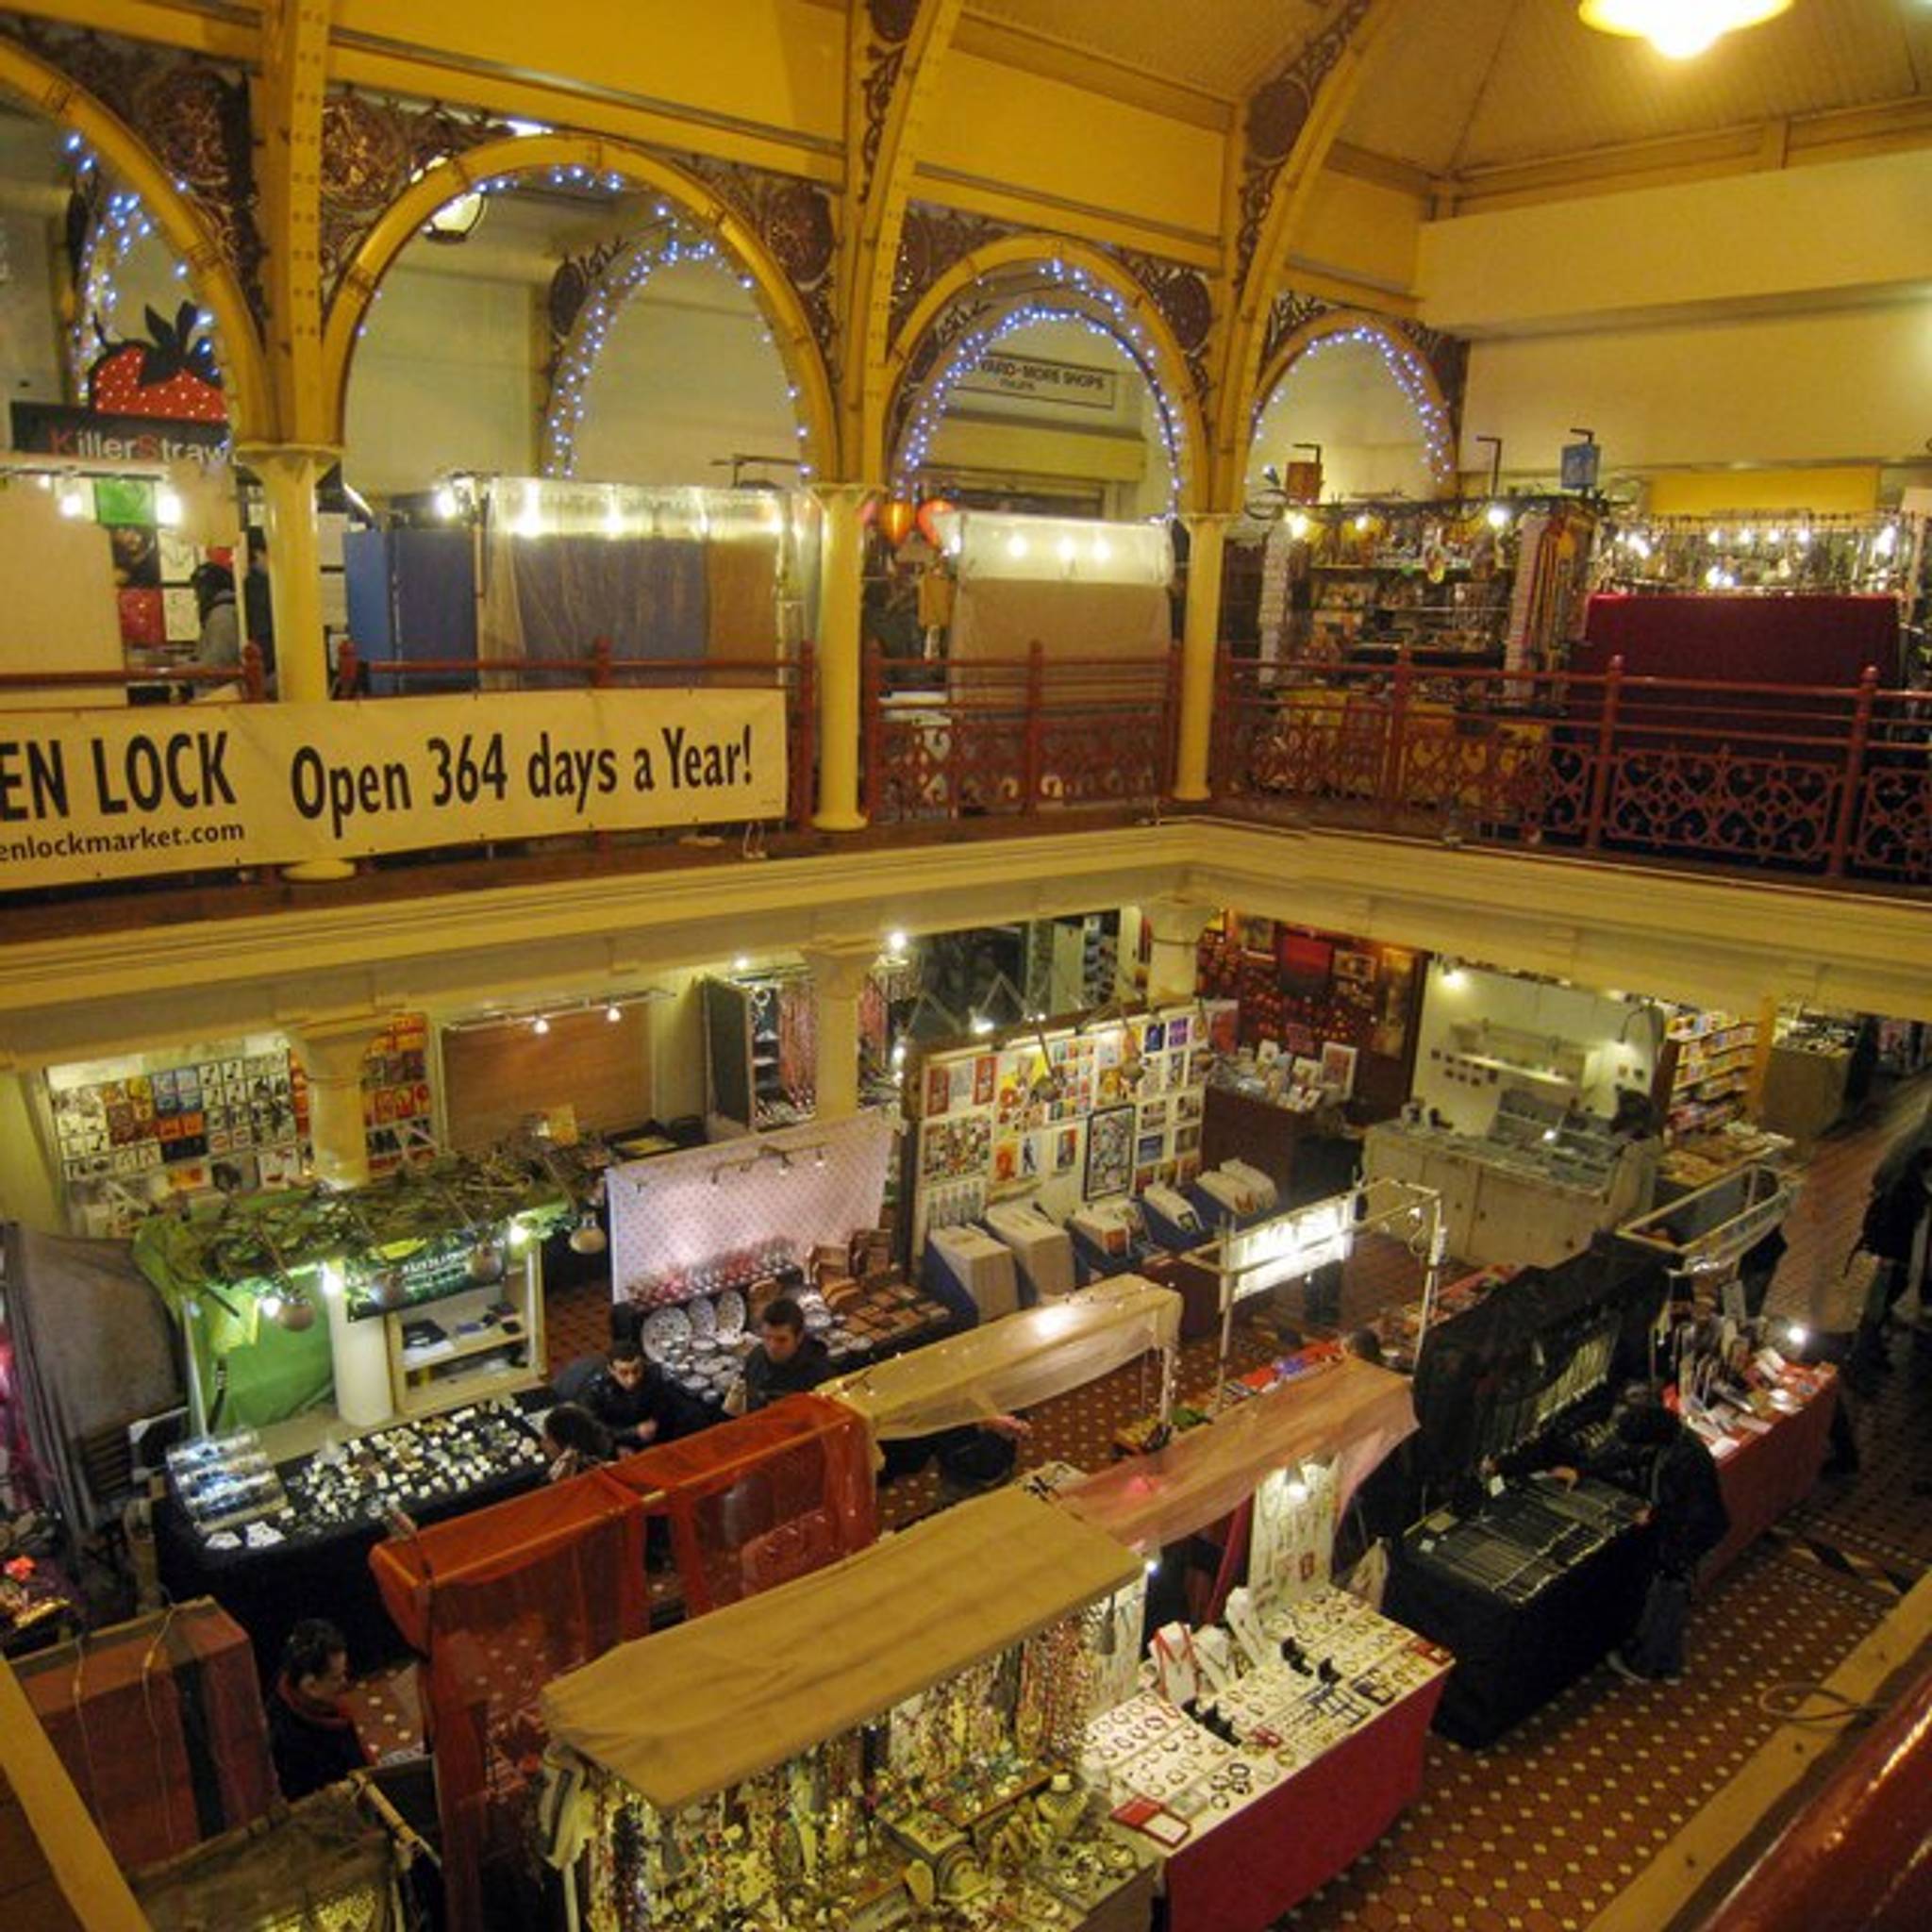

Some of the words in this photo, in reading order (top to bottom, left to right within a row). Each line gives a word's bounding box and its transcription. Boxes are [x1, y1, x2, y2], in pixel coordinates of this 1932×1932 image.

[0, 739, 70, 822] EN
[91, 730, 238, 815] LOCK
[291, 745, 412, 840] Open
[427, 733, 508, 807] 364
[528, 731, 618, 814] days
[633, 748, 656, 792] a
[661, 724, 753, 790] Year!
